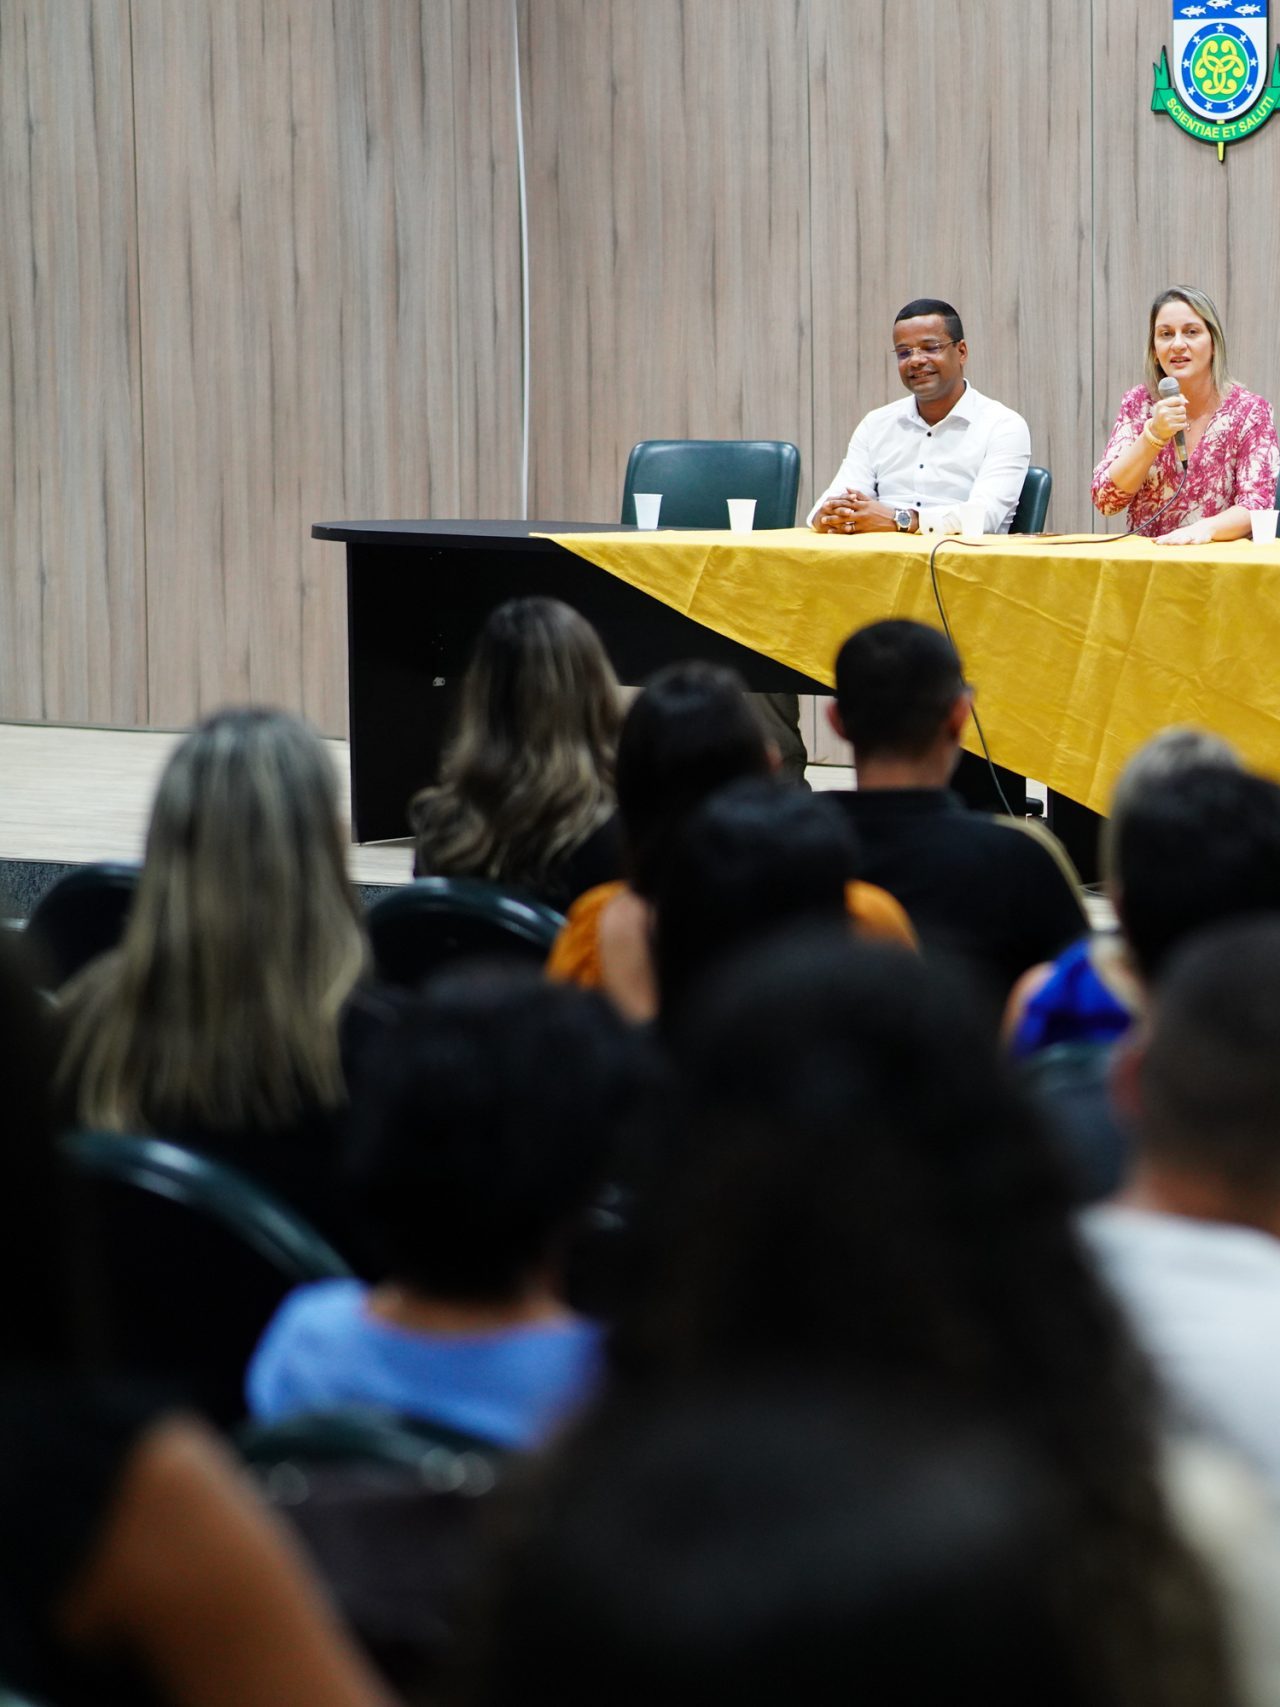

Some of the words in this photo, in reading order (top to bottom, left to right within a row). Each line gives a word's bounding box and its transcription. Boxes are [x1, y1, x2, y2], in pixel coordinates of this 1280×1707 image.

[1166, 97, 1220, 138] SCIENTIAE
[1222, 124, 1237, 138] ET
[1238, 96, 1275, 133] SALUTI
